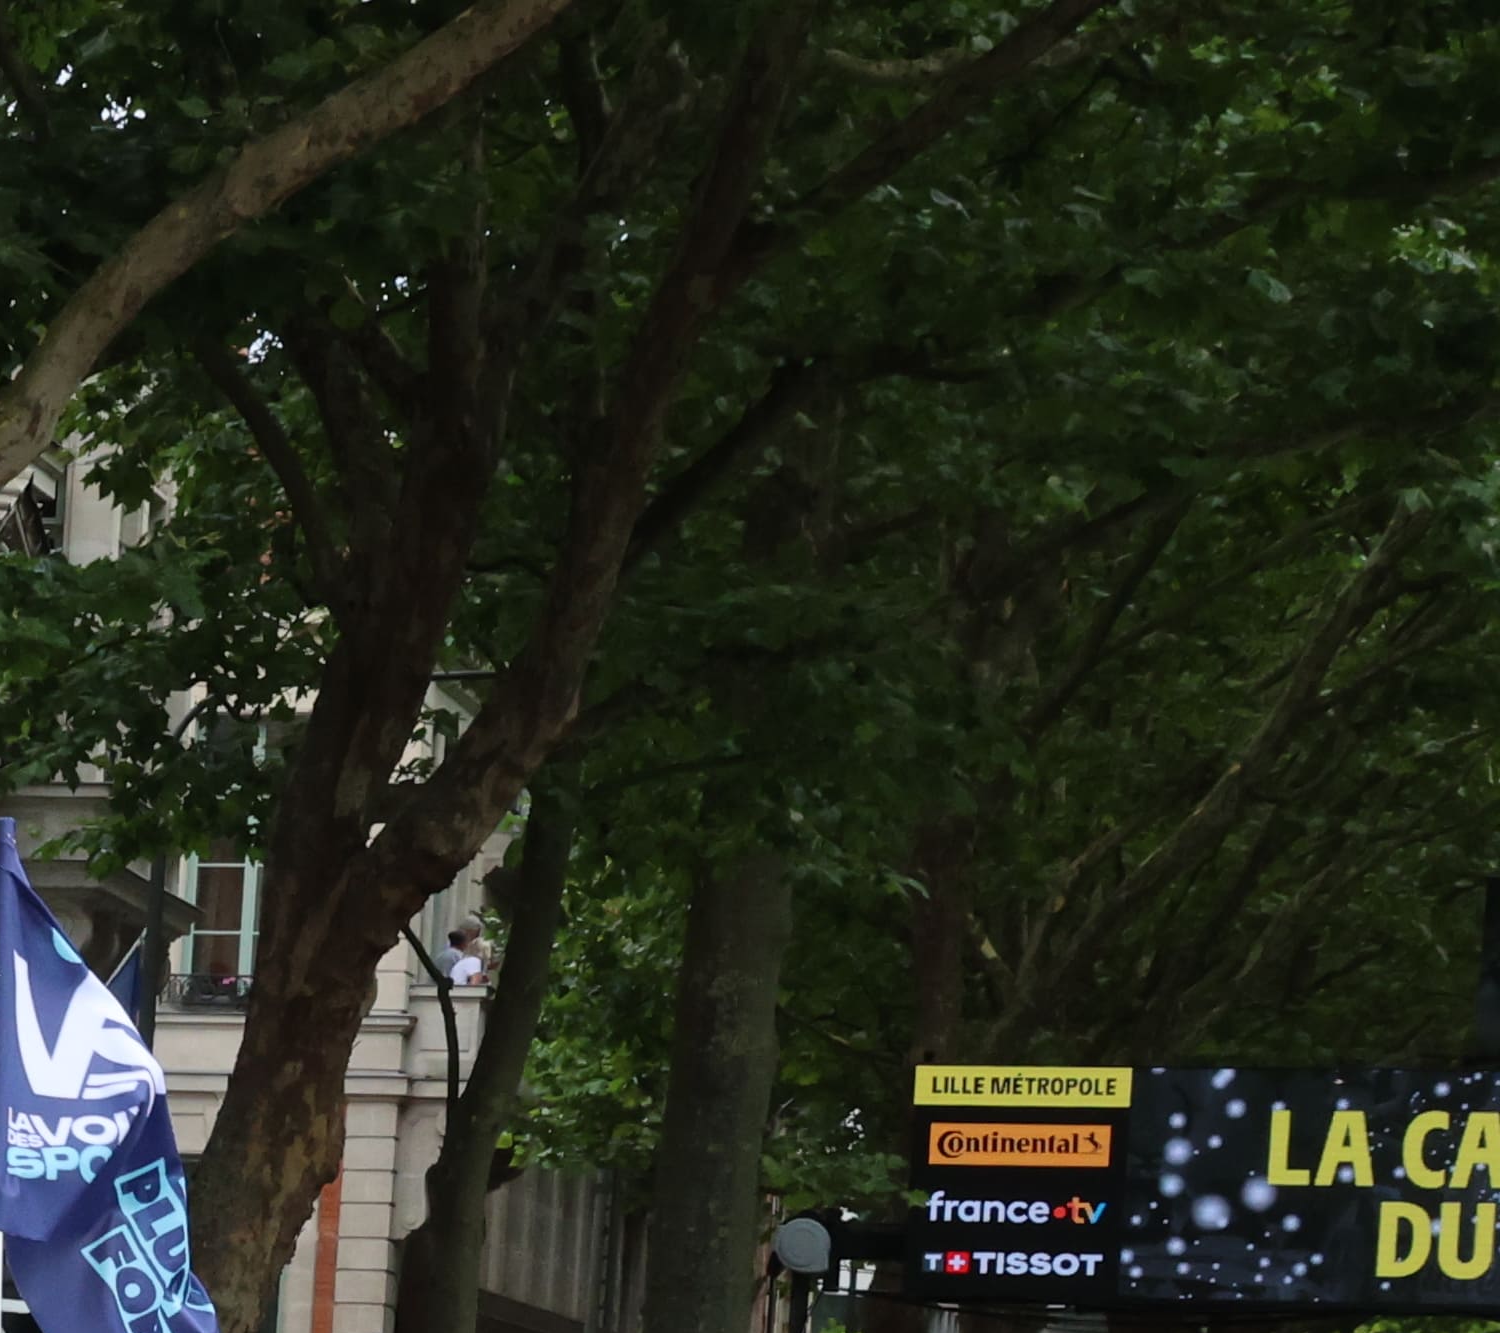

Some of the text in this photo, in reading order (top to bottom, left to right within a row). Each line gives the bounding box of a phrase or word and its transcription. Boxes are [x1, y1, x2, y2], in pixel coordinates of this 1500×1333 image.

[932, 1073, 1117, 1096] LILLE MÉTROPOLE
[8, 1107, 34, 1133] LA
[8, 1127, 44, 1149] DES
[937, 1131, 1079, 1159] Continental
[1267, 1110, 1374, 1187] LA
[1376, 1202, 1497, 1280] DU
[972, 1252, 1103, 1277] TISSOT
